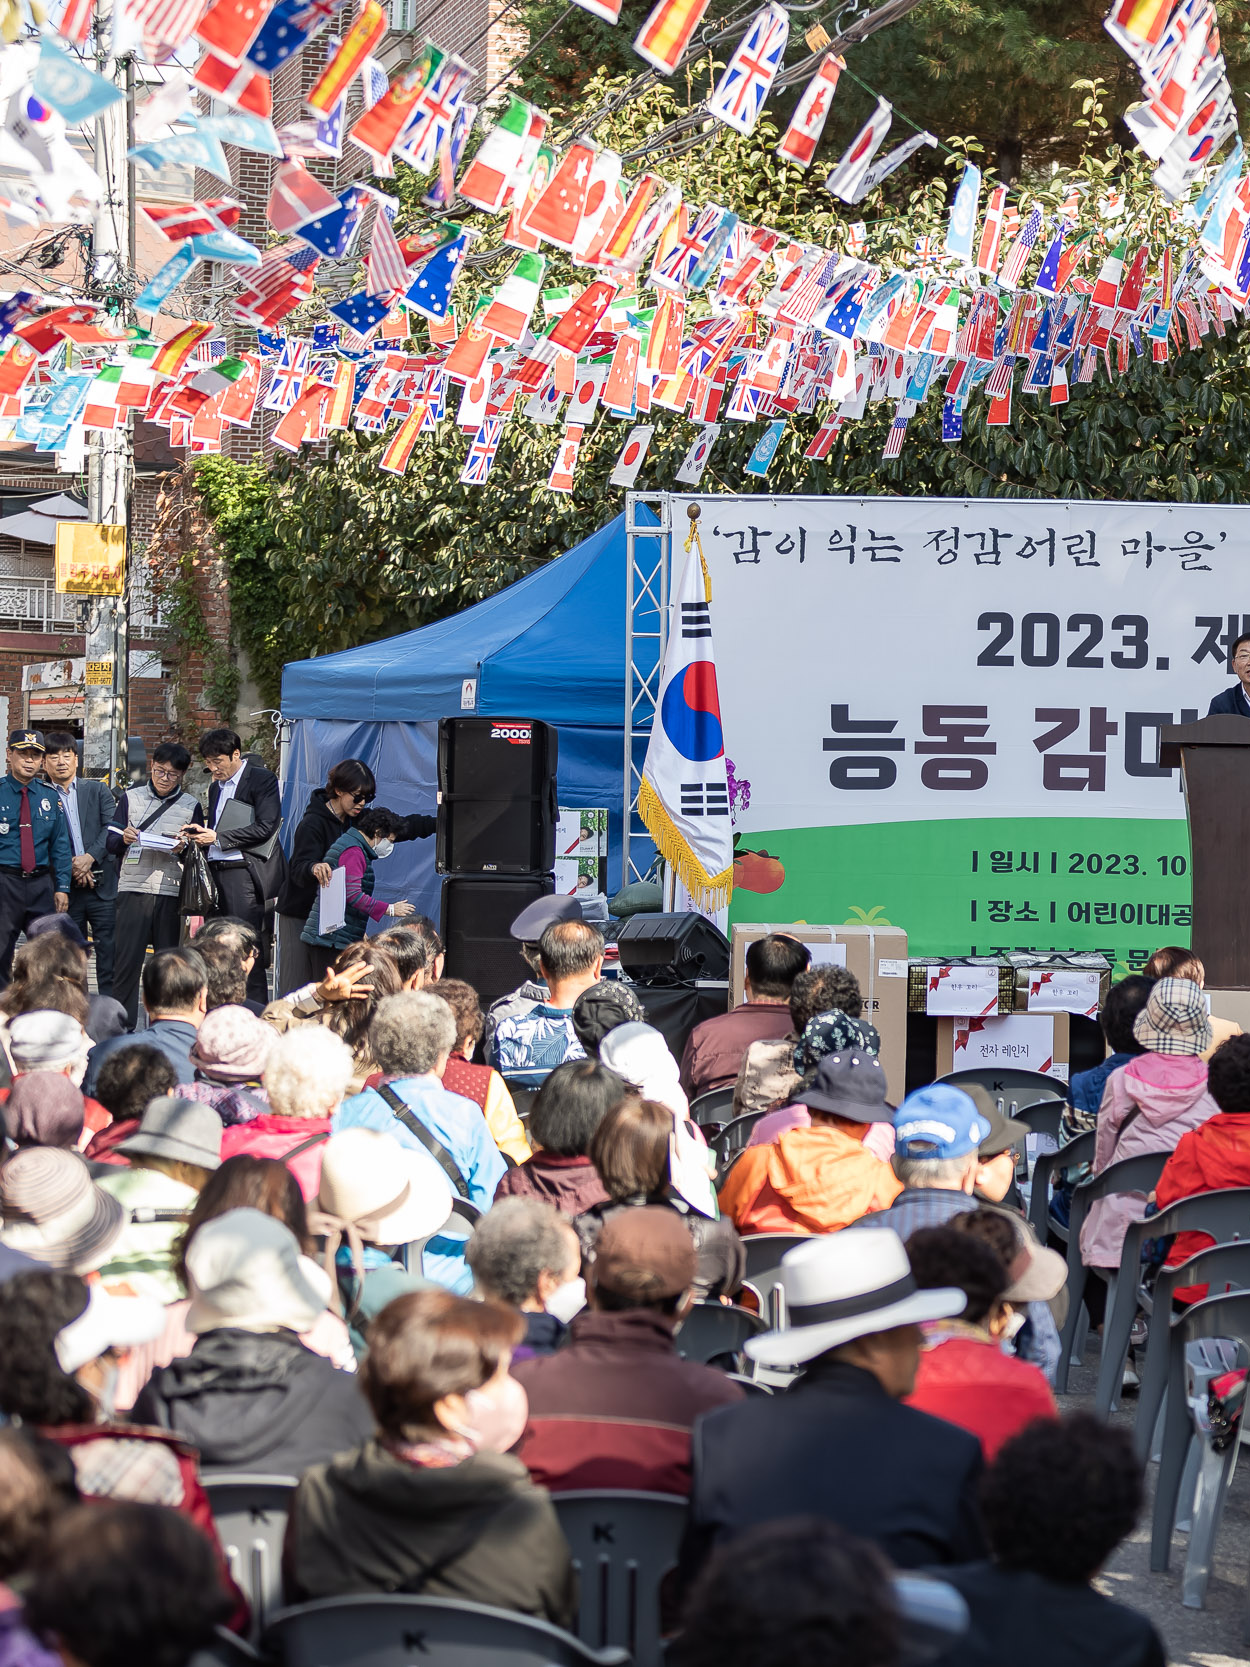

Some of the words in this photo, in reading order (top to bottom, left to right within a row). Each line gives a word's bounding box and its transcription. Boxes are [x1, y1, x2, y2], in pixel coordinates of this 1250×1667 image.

[827, 524, 904, 564] 익는
[923, 526, 1100, 567] 정감어린
[977, 611, 1170, 671] 2023.
[490, 728, 530, 739] 2000
[822, 704, 997, 791] 능동
[989, 850, 1040, 874] 일시
[1068, 853, 1148, 876] 2023.
[1156, 855, 1193, 877] 10
[987, 900, 1040, 924] 장소
[1067, 901, 1193, 927] 어린이대공
[979, 1044, 999, 1058] 전자
[1001, 1044, 1030, 1058] 레인지
[993, 1081, 1004, 1092] K
